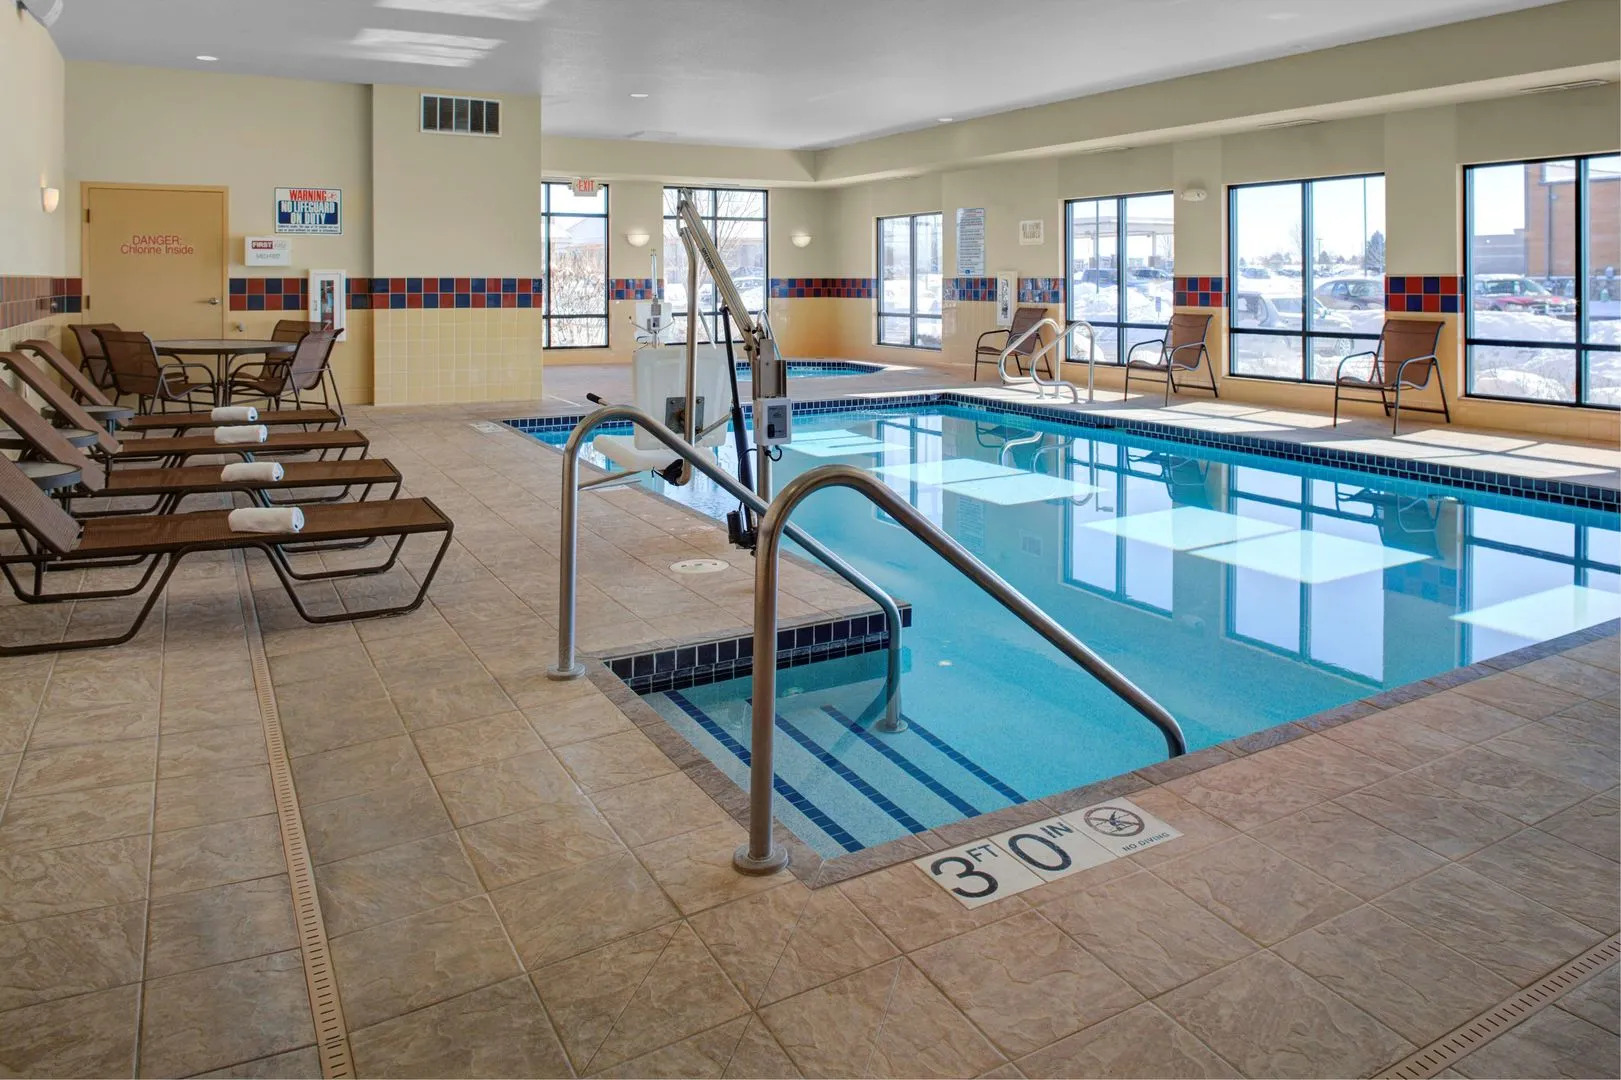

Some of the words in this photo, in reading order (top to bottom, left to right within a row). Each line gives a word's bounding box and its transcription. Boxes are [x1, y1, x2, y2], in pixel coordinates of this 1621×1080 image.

[578, 179, 594, 192] EXIT
[290, 190, 326, 201] WARNING
[281, 201, 292, 213] NO
[293, 202, 336, 214] LIFEGUARD
[290, 212, 302, 224] ON
[304, 213, 326, 225] DUTY
[120, 244, 162, 254] Chlorine
[165, 244, 194, 254] Inside
[1122, 843, 1137, 851] NO
[1138, 832, 1170, 846] DIVING
[930, 856, 998, 898] 3
[966, 844, 998, 863] FT
[1008, 833, 1072, 871] 0
[1040, 821, 1074, 838] IN
